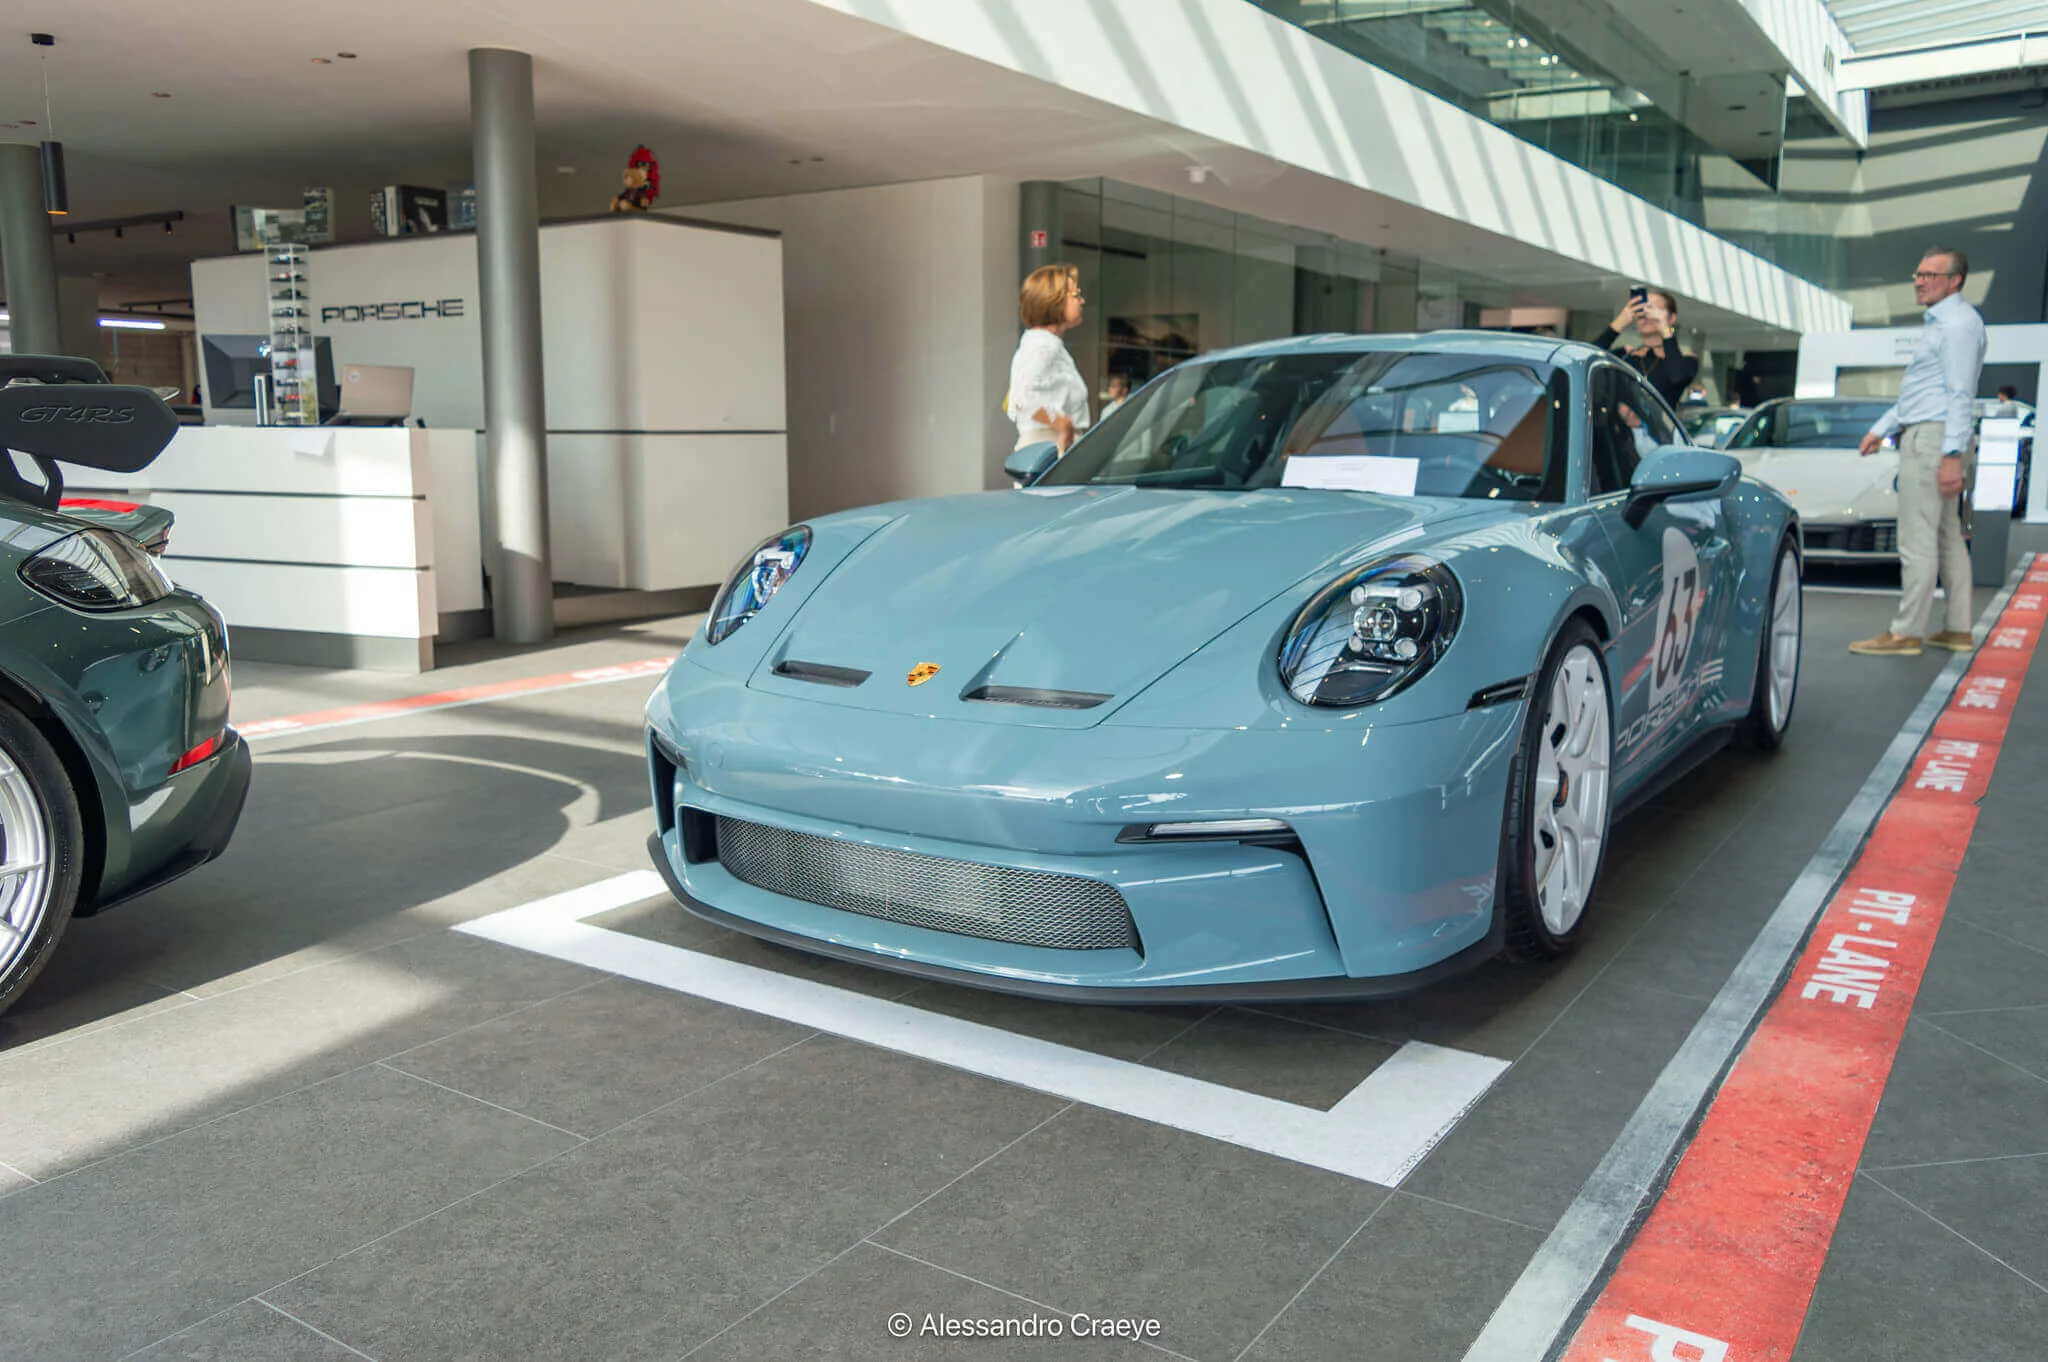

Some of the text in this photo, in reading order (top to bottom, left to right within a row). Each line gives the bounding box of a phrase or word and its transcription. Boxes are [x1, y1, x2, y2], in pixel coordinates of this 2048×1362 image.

[320, 298, 465, 324] PORSCHE
[1656, 566, 1697, 690] 63
[1615, 657, 1725, 752] PORSCHE
